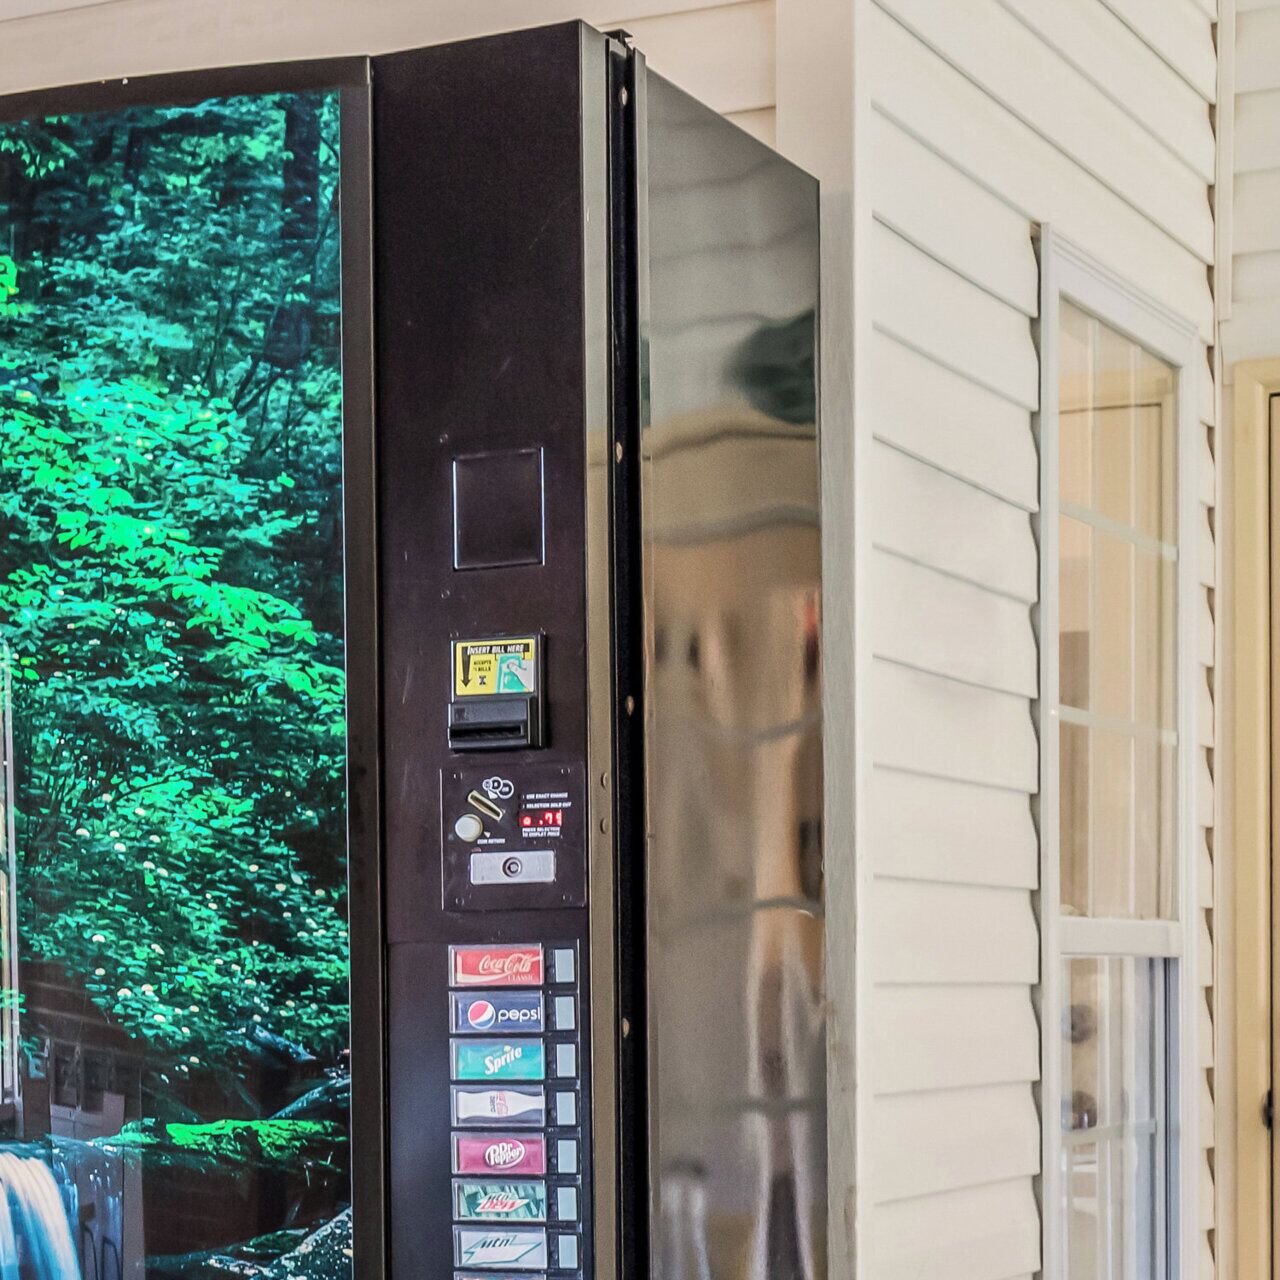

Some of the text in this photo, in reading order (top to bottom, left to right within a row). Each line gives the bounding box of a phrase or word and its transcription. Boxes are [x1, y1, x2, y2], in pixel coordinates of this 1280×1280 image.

[467, 645, 490, 655] INSERT
[498, 1006, 541, 1023] pepsi
[484, 1045, 522, 1075] Sprite
[489, 1144, 522, 1166] Pepper
